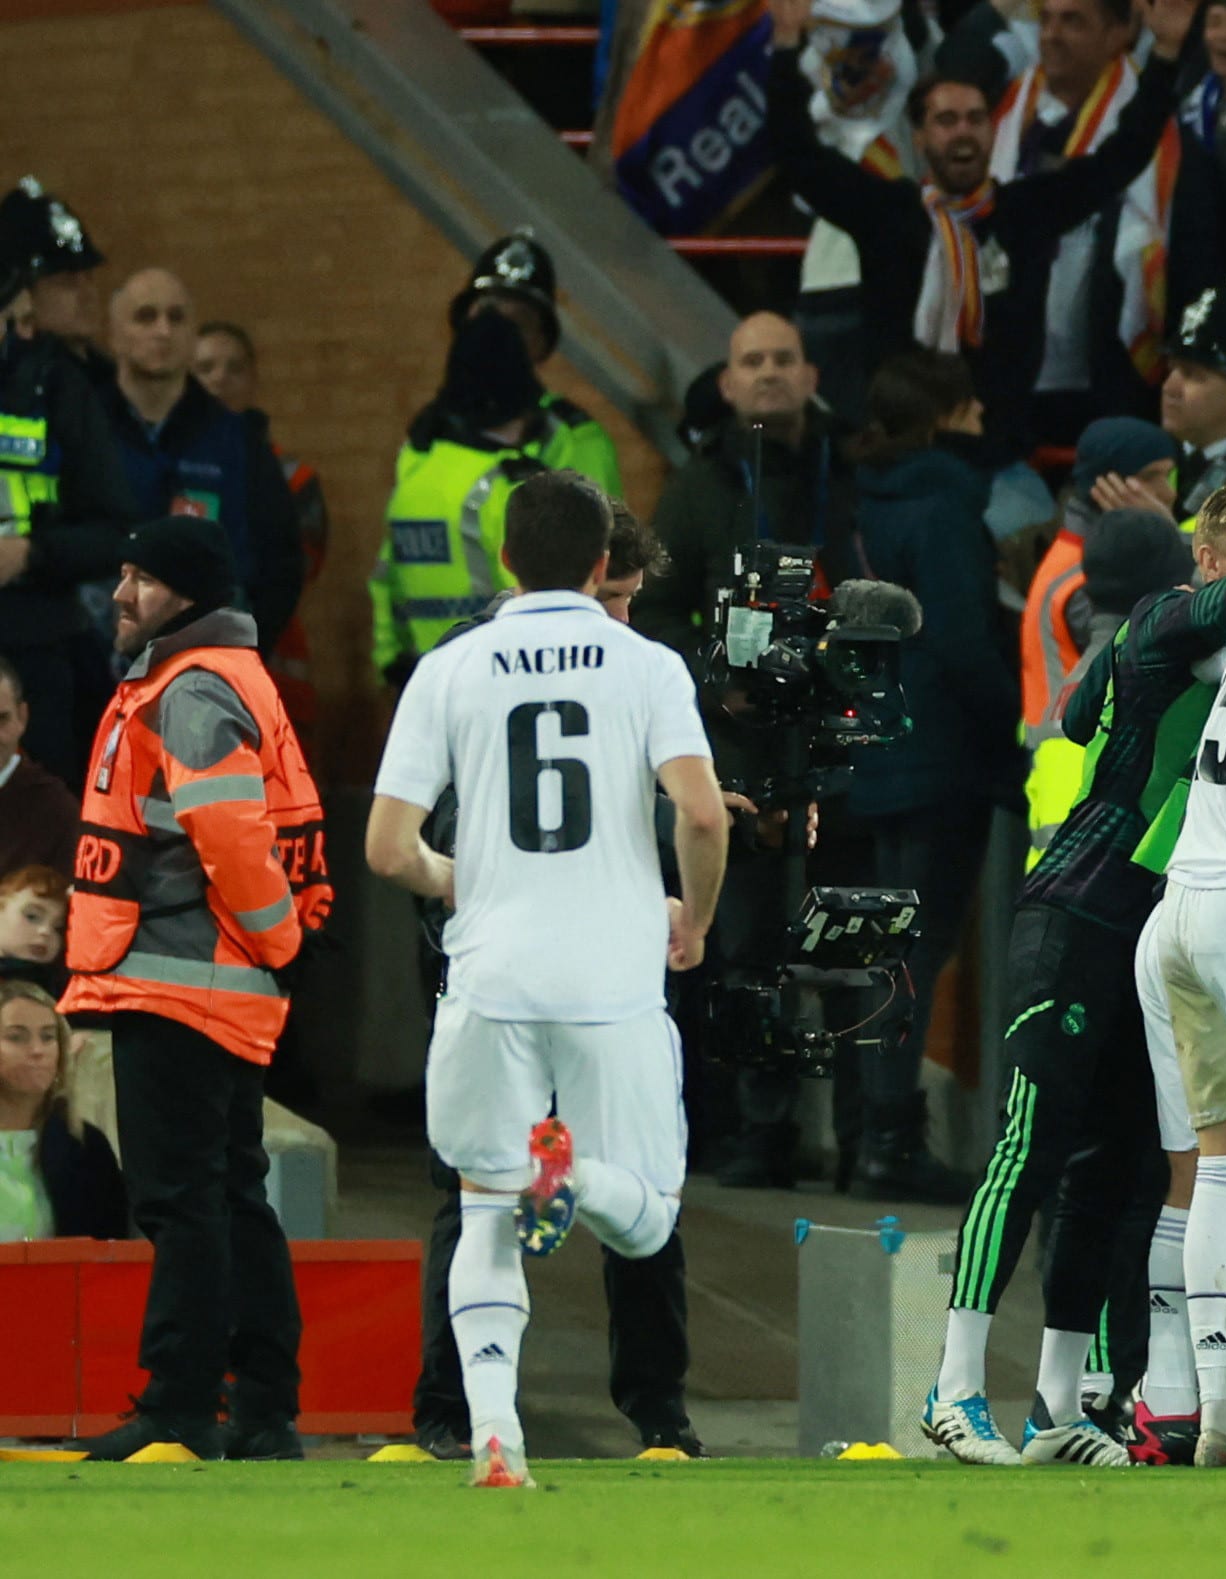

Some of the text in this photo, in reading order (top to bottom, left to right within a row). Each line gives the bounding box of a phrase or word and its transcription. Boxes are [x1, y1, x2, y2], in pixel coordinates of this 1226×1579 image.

[651, 70, 767, 208] Real
[491, 645, 605, 677] NACHO
[507, 700, 592, 853] 6
